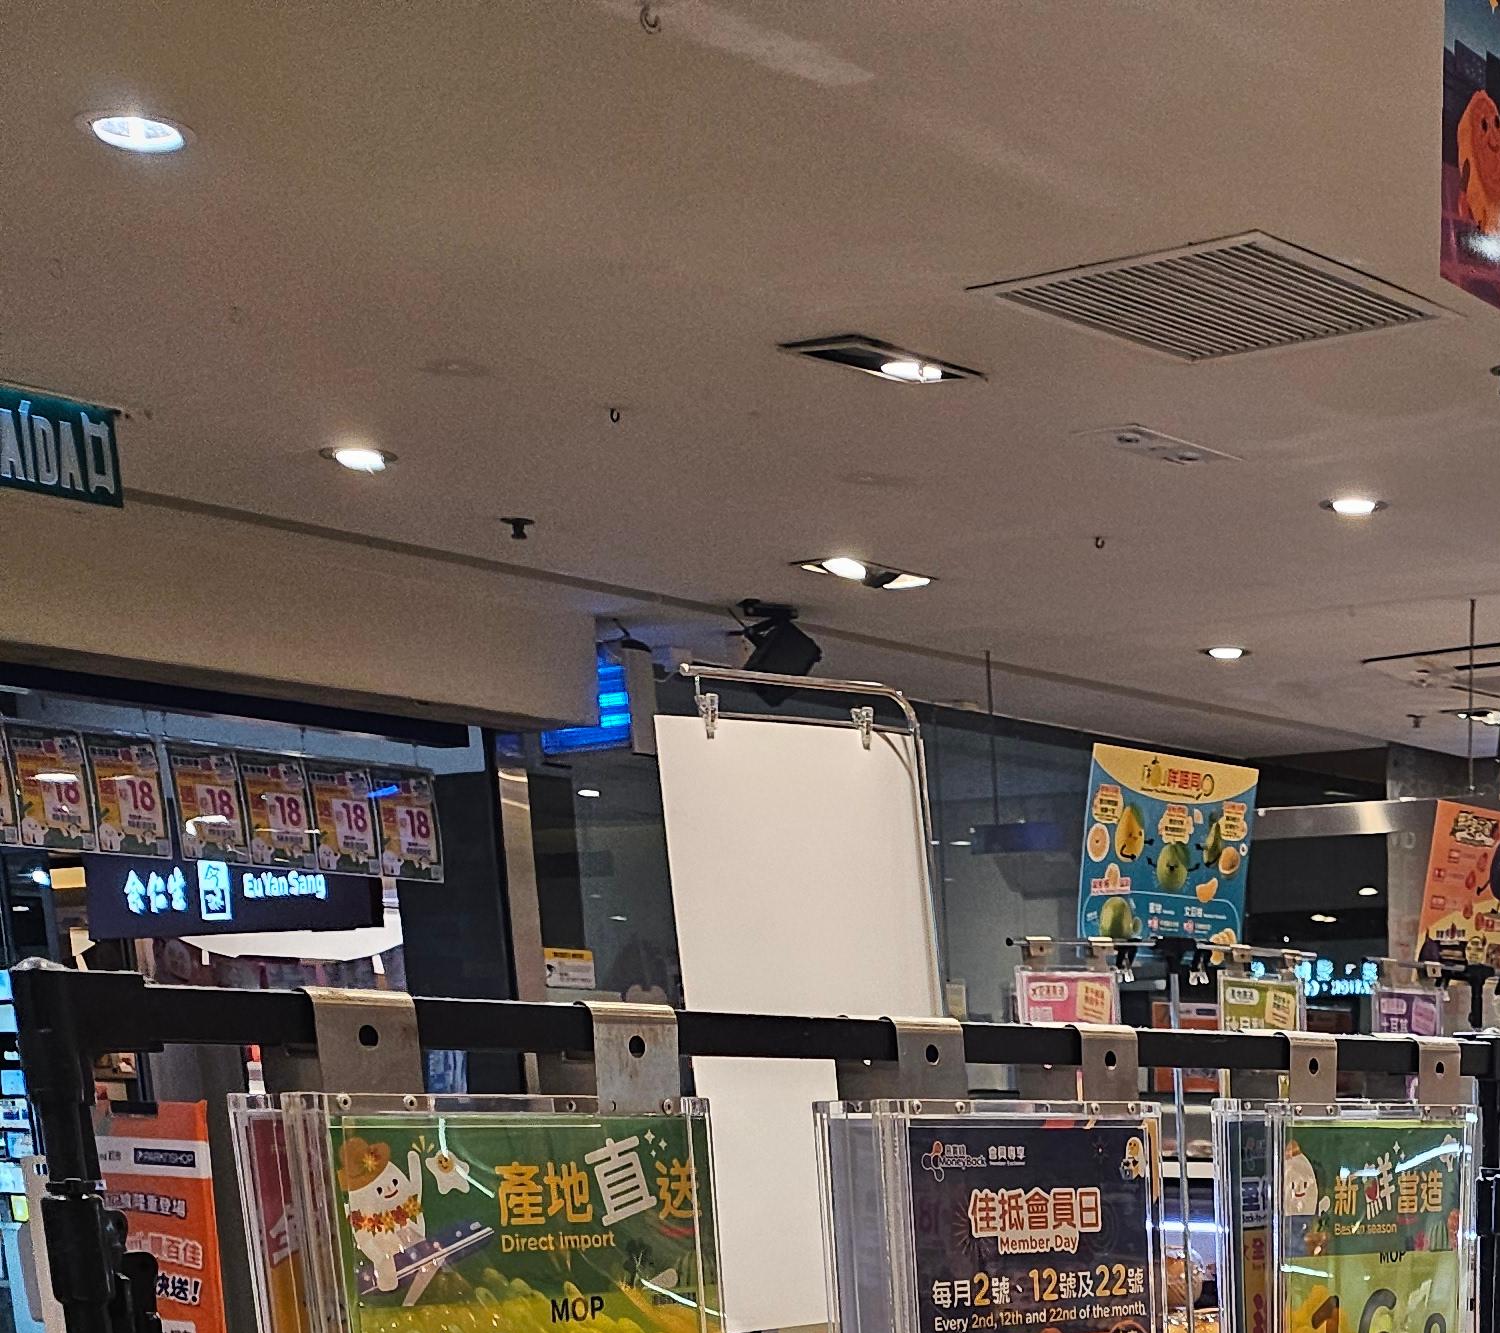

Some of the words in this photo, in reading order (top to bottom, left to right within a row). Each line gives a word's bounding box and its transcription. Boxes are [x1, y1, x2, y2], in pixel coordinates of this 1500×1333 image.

[126, 780, 155, 811] 18
[206, 786, 235, 818] 18
[275, 793, 300, 826] 18
[341, 800, 368, 832] 18
[404, 808, 431, 839] 18
[499, 1134, 701, 1231] 產地直送
[1334, 1152, 1443, 1220] 新鮮當造
[972, 1189, 1100, 1234] 佳抵會員日
[501, 1231, 555, 1253] Direct
[999, 1236, 1050, 1251] Member
[1055, 1234, 1078, 1250] Day
[1367, 1223, 1398, 1234] season
[1380, 1250, 1407, 1264] MOP
[551, 1296, 605, 1324] MOP
[934, 1316, 969, 1333] Every
[972, 1313, 997, 1330] 2nd,
[1000, 1311, 1023, 1326] 12th
[1025, 1309, 1047, 1324] and
[1050, 1307, 1077, 1321] 22nd
[1079, 1305, 1092, 1319] of
[1092, 1303, 1111, 1318] the
